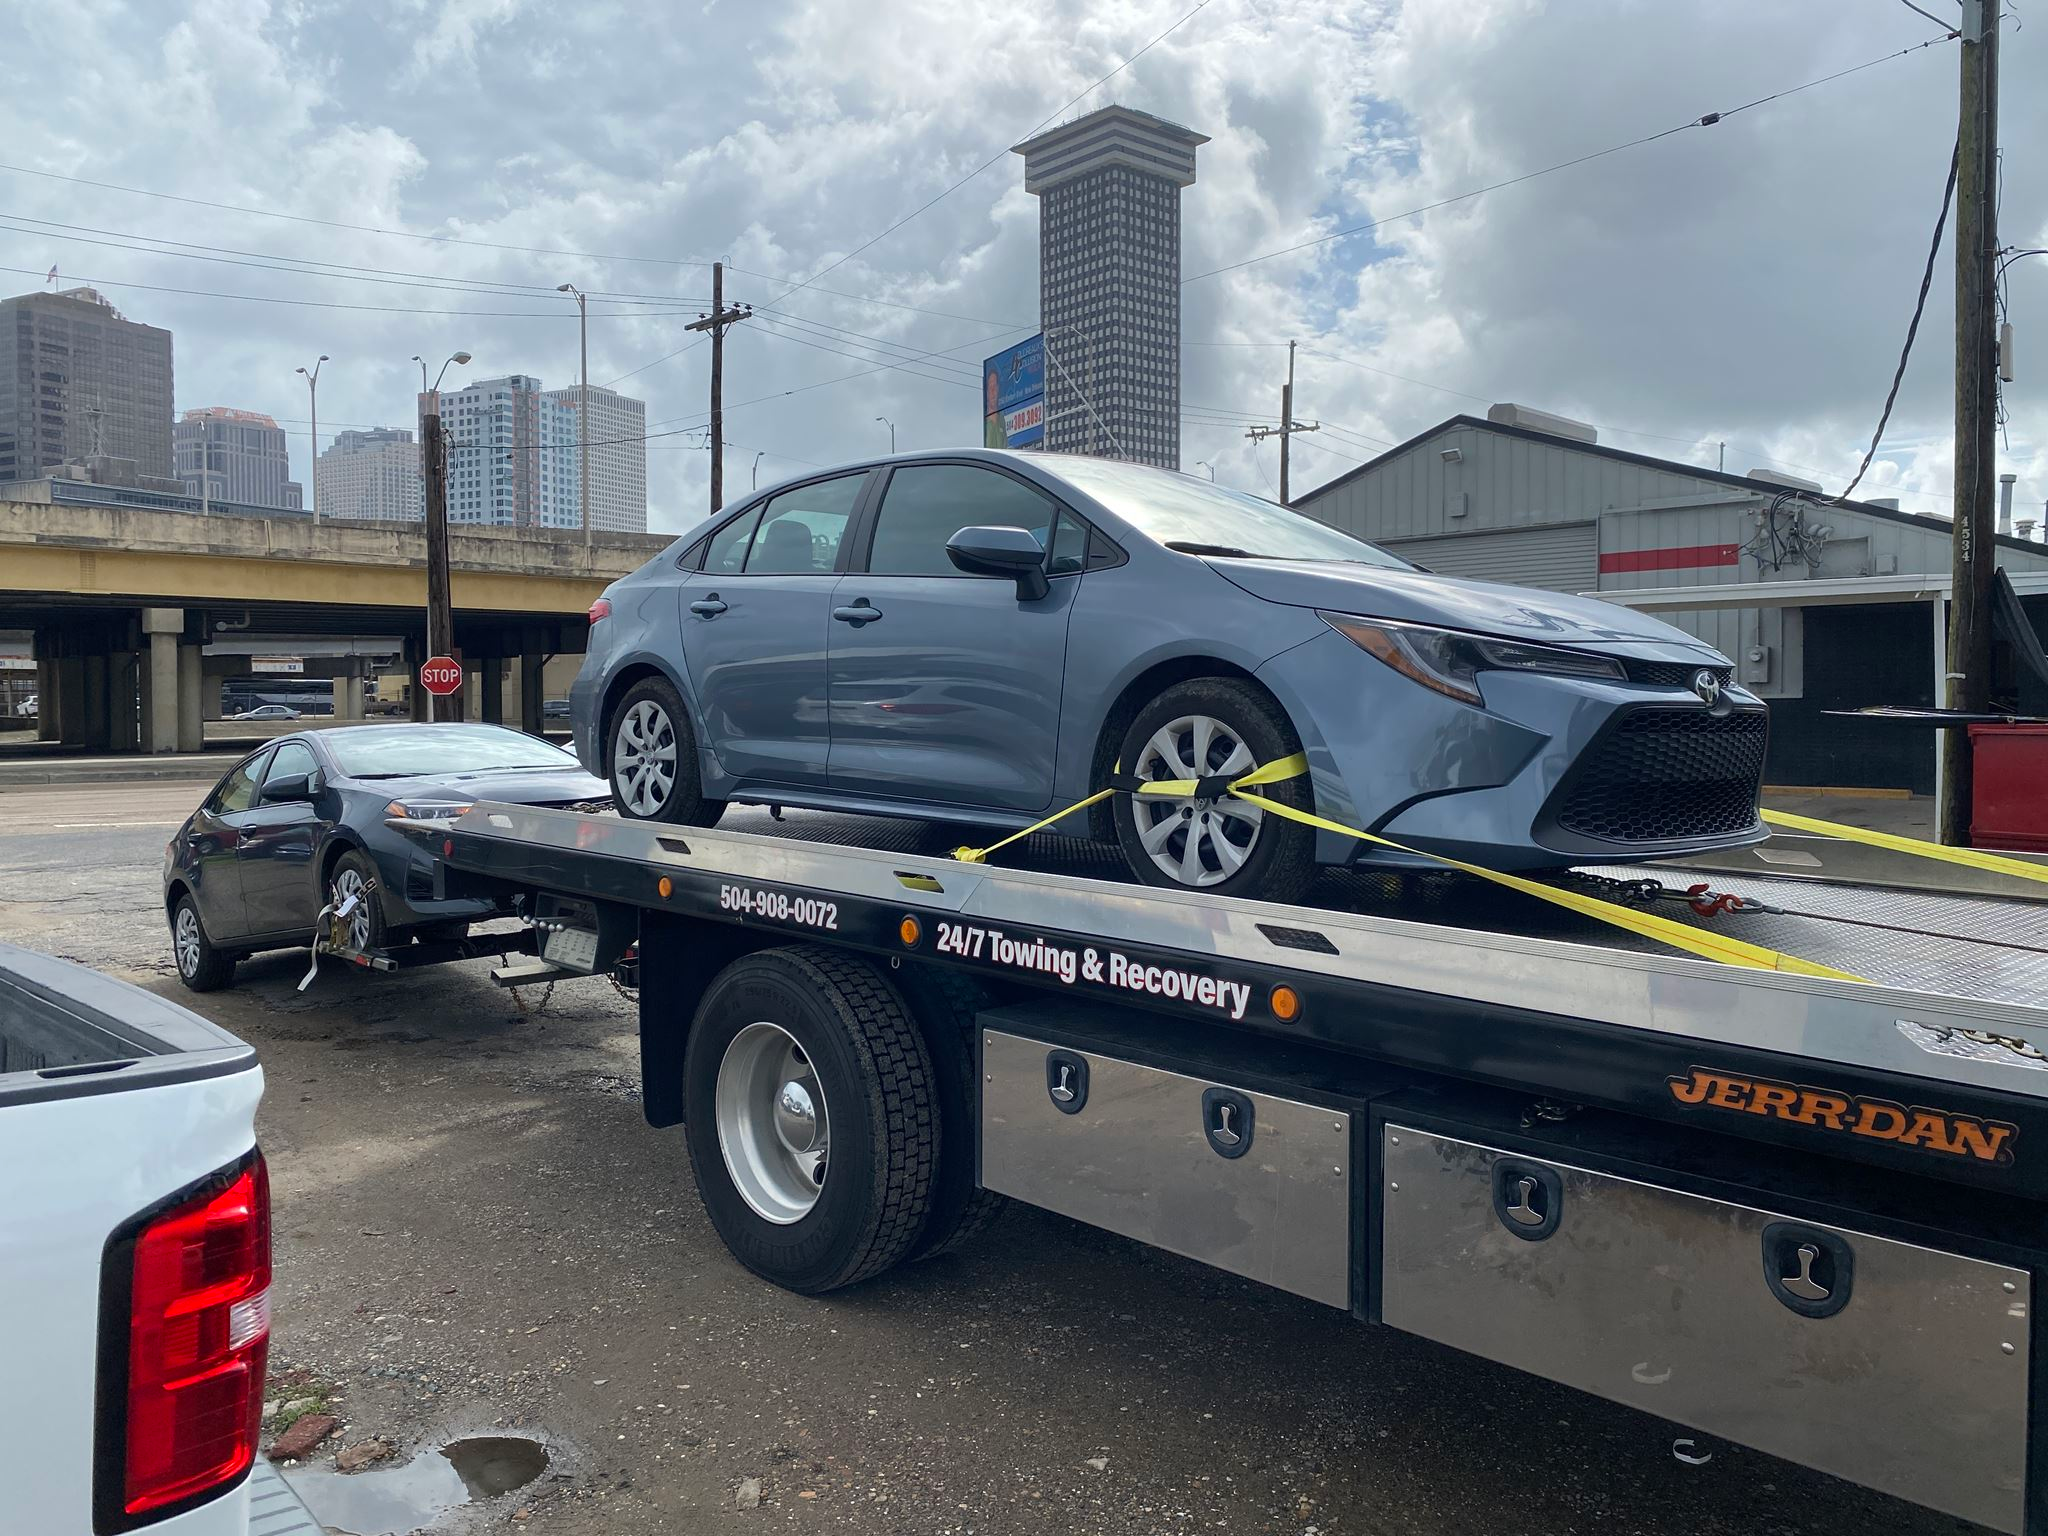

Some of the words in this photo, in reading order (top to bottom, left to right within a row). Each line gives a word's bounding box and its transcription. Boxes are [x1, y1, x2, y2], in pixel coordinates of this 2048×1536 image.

[1961, 516, 1971, 562] 4534
[424, 669, 459, 683] STOP
[720, 885, 838, 931] 504-908-0072
[937, 922, 986, 959] 24/7
[988, 931, 1078, 984] Towing
[1082, 948, 1105, 984] &
[1109, 953, 1252, 1021] Recovery
[1669, 1071, 2012, 1162] JERR-DAN
